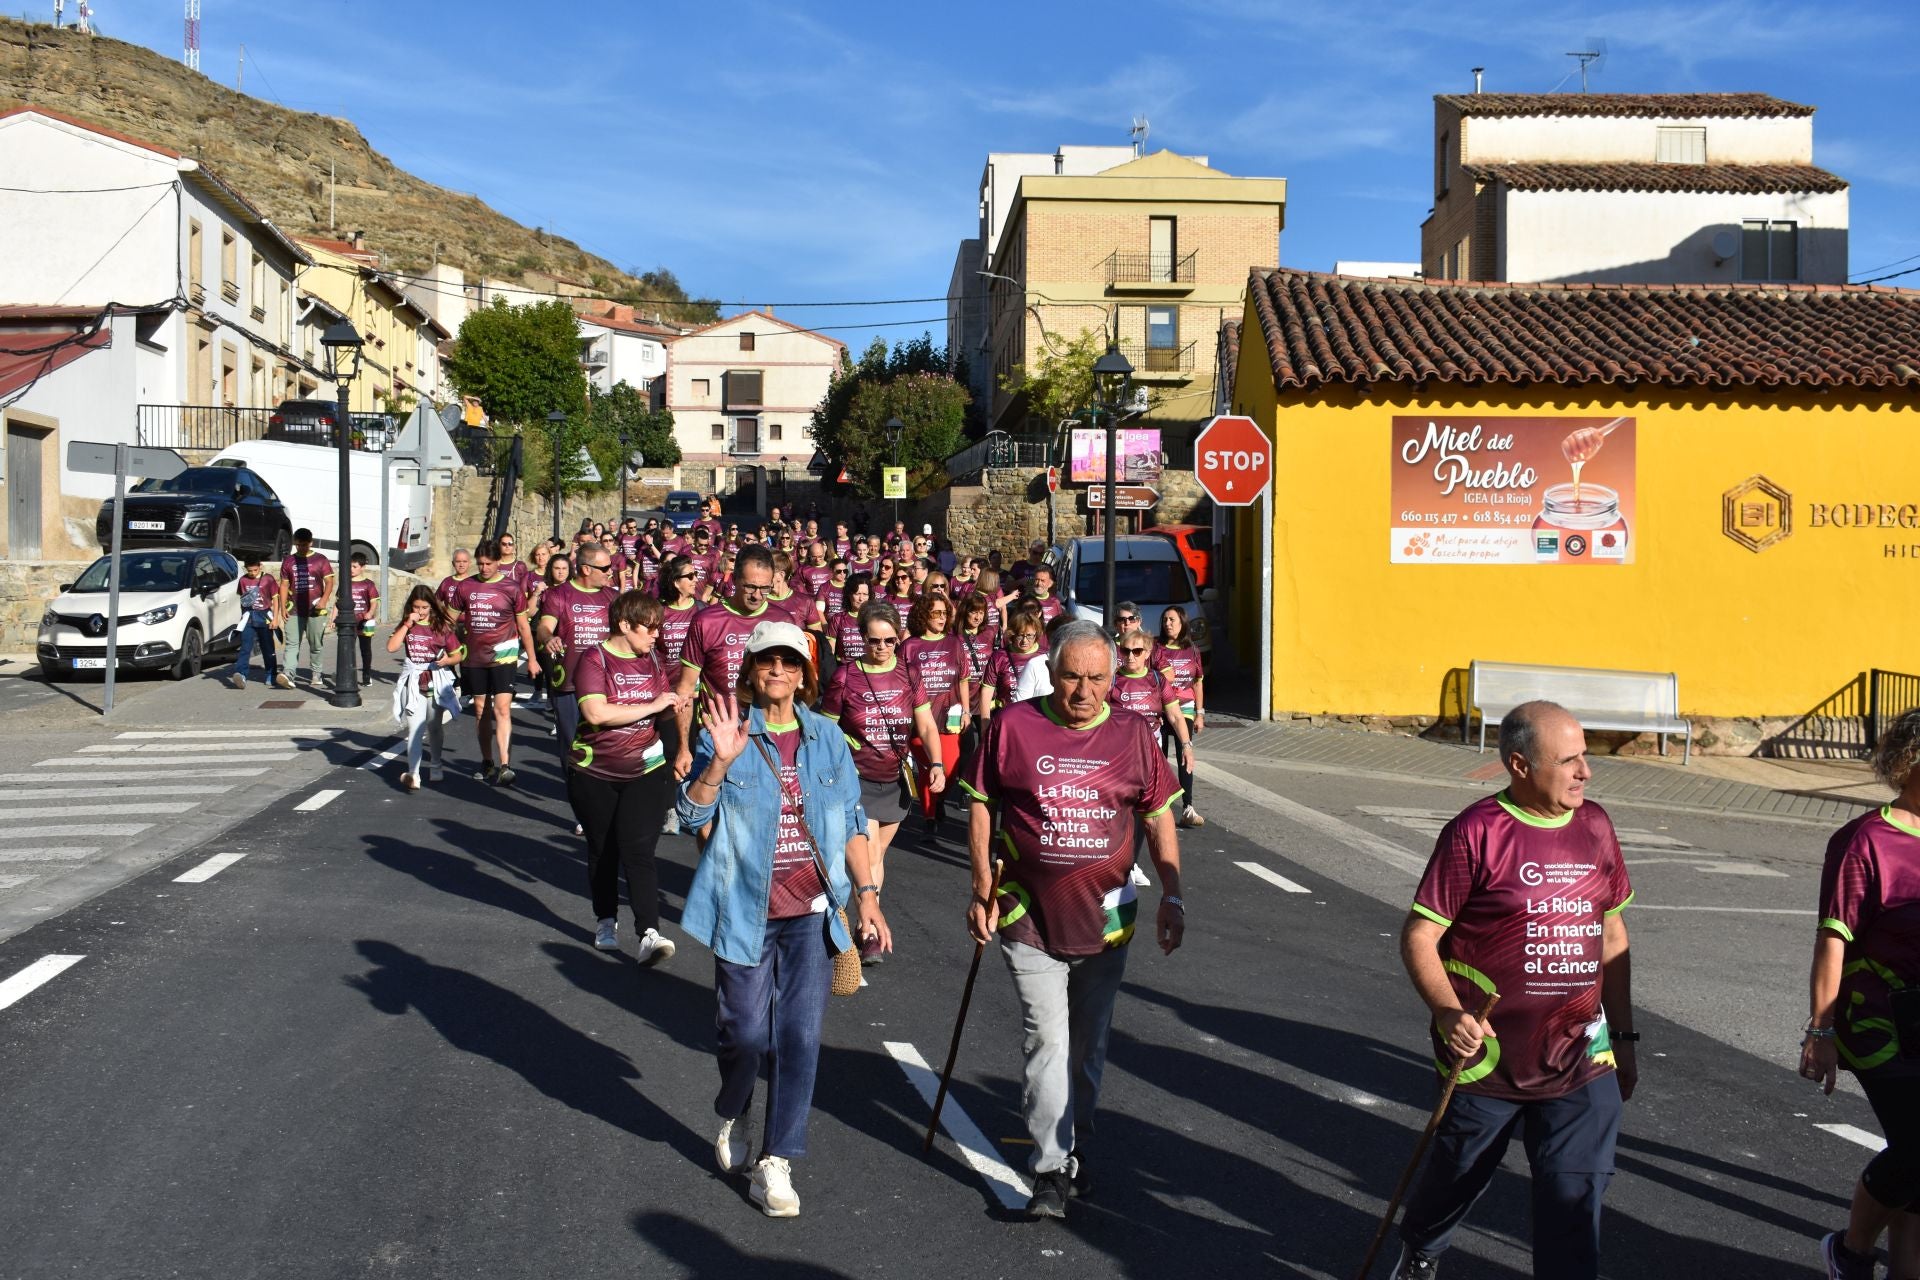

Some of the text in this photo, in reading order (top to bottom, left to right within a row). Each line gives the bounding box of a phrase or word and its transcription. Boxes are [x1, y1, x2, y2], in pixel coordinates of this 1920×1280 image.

[1126, 433, 1148, 441] Igea
[1402, 422, 1514, 464] Miel del
[1204, 450, 1264, 471] STOP
[1434, 454, 1538, 494] Pueblo
[1464, 493, 1532, 505] IGEA (La Rioja)
[1401, 510, 1531, 524] 660 115 417 618 854 401
[1809, 503, 1920, 528] BODEG
[618, 690, 652, 699] La Rioja
[880, 706, 901, 715] Rioja
[1039, 785, 1098, 802] La Rioja
[1040, 804, 1058, 817] En
[1042, 820, 1089, 832] contra
[1040, 833, 1110, 848] el cáncer
[1527, 897, 1593, 916] La Rioja
[1526, 921, 1602, 938] En marcha
[1524, 940, 1584, 955] contra
[1524, 958, 1599, 974] el cáncer
